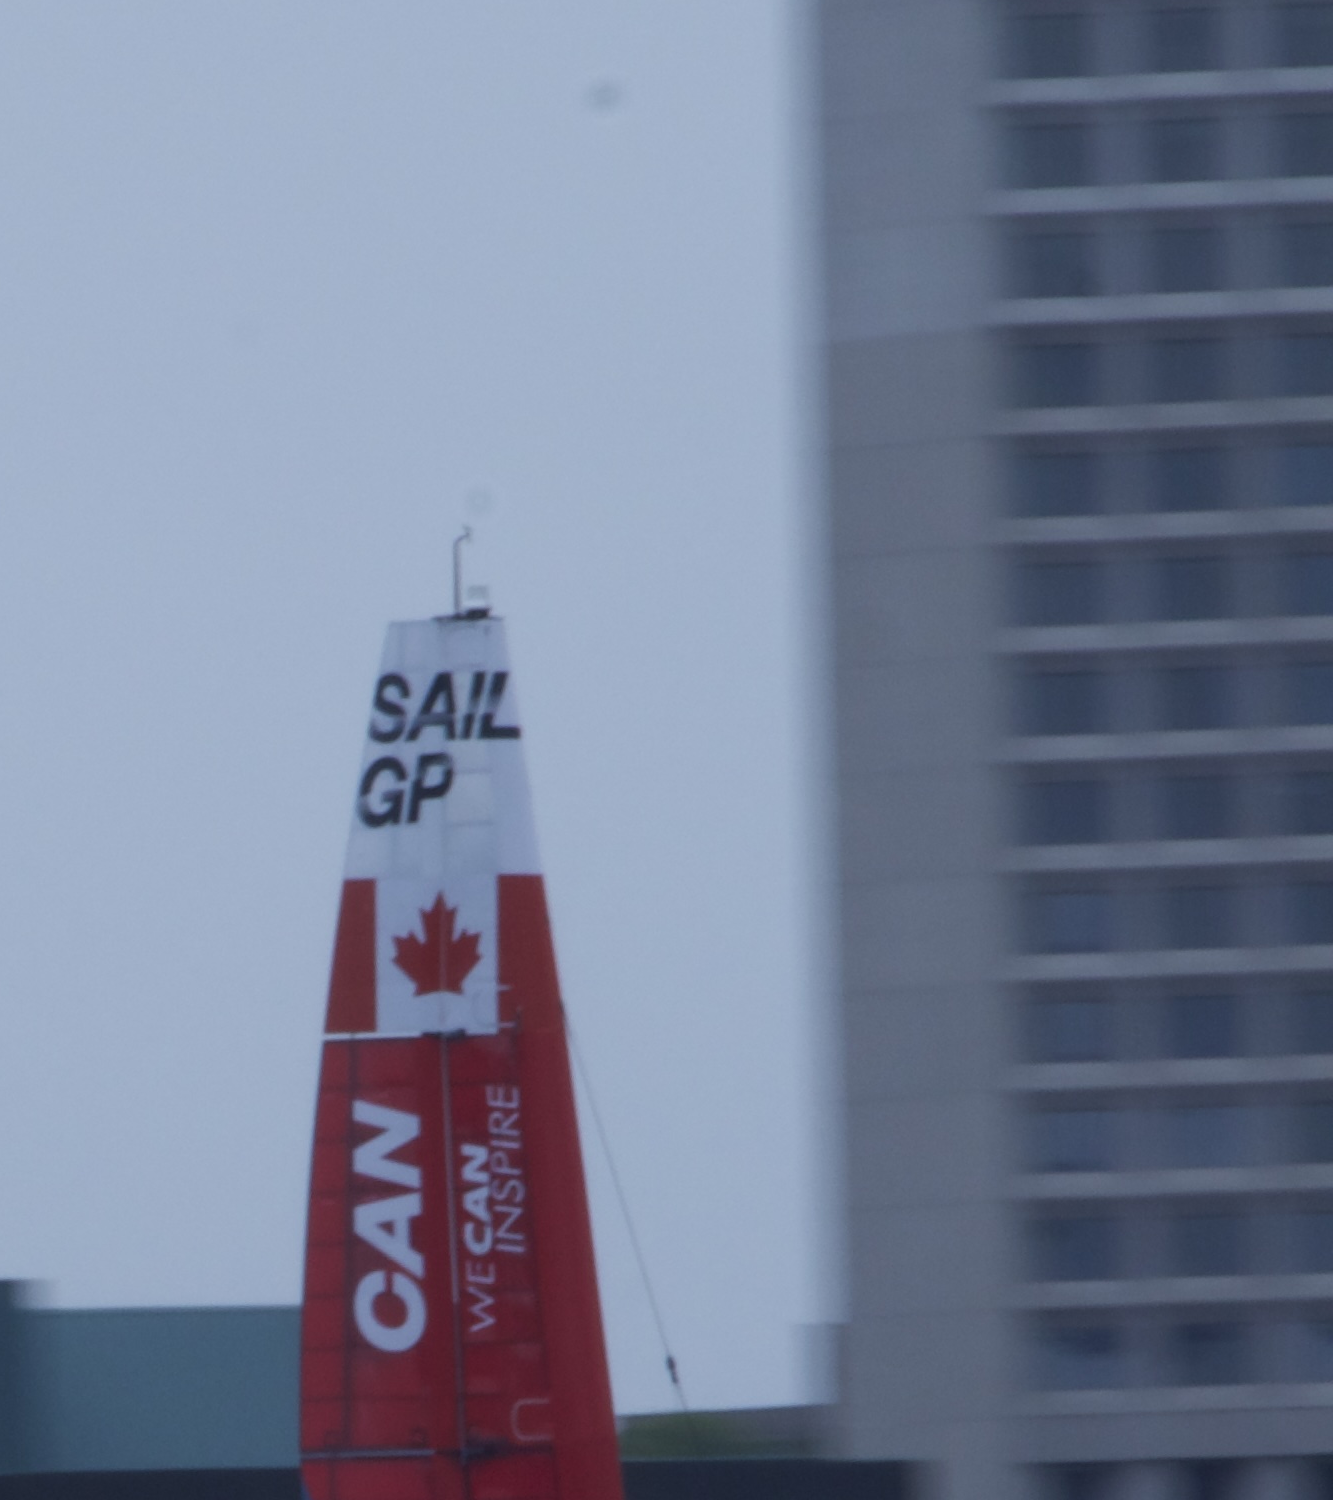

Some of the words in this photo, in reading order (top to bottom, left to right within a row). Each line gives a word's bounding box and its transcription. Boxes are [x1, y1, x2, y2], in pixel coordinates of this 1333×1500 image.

[369, 671, 521, 743] SAIL
[357, 751, 454, 828] GP
[460, 1143, 493, 1256] CAN
[485, 1083, 526, 1253] INSPIRE
[352, 1099, 427, 1354] CAN
[465, 1260, 496, 1333] WE
